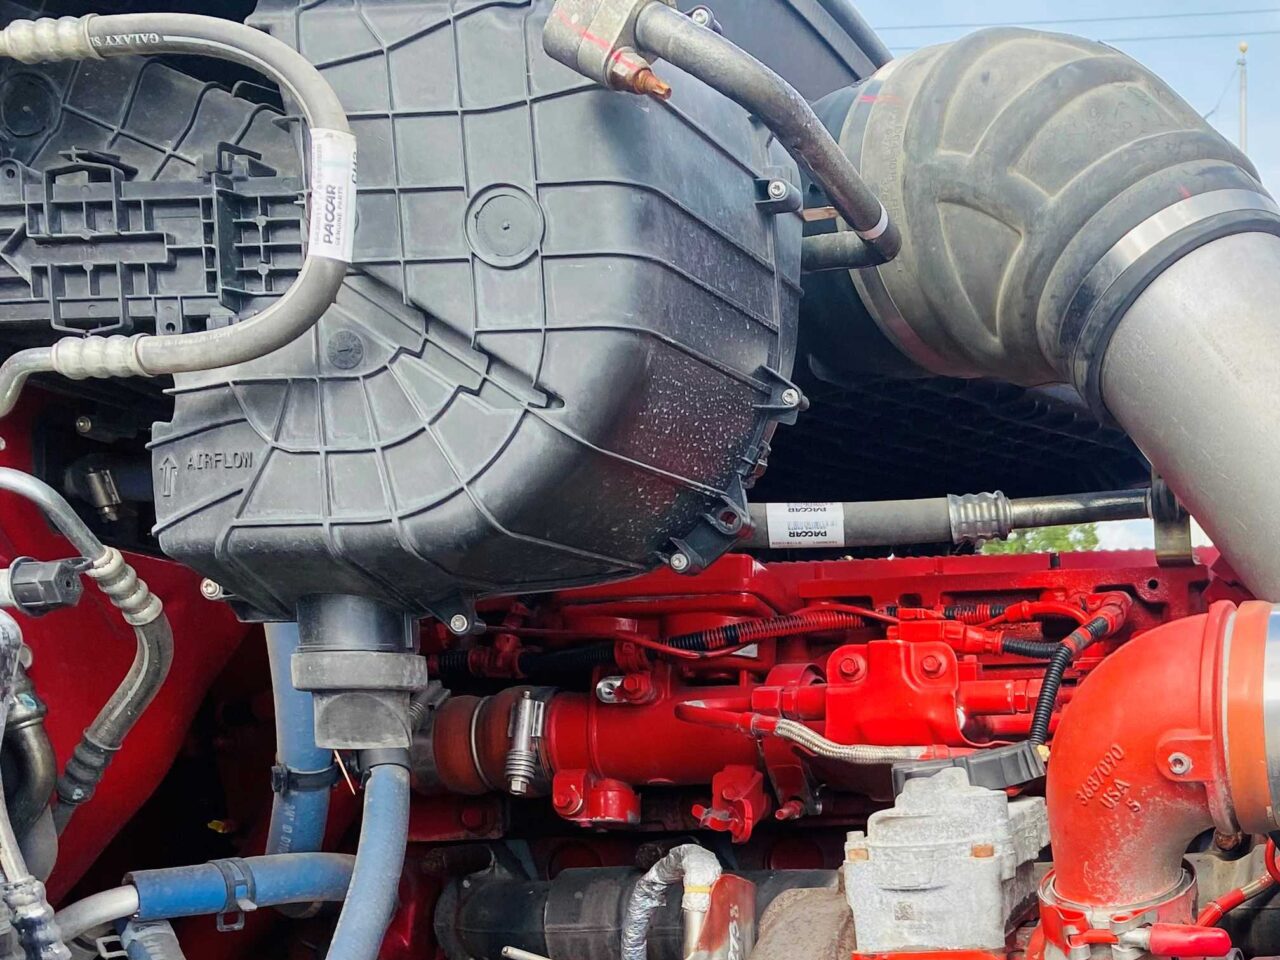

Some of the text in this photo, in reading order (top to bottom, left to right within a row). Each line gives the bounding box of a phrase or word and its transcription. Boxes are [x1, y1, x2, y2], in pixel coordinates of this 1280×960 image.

[105, 33, 159, 45] GALAXY
[323, 184, 336, 244] PACCAR
[187, 452, 253, 470] AIRFLOW
[1076, 744, 1124, 806] 3687090
[1100, 779, 1130, 809] USA
